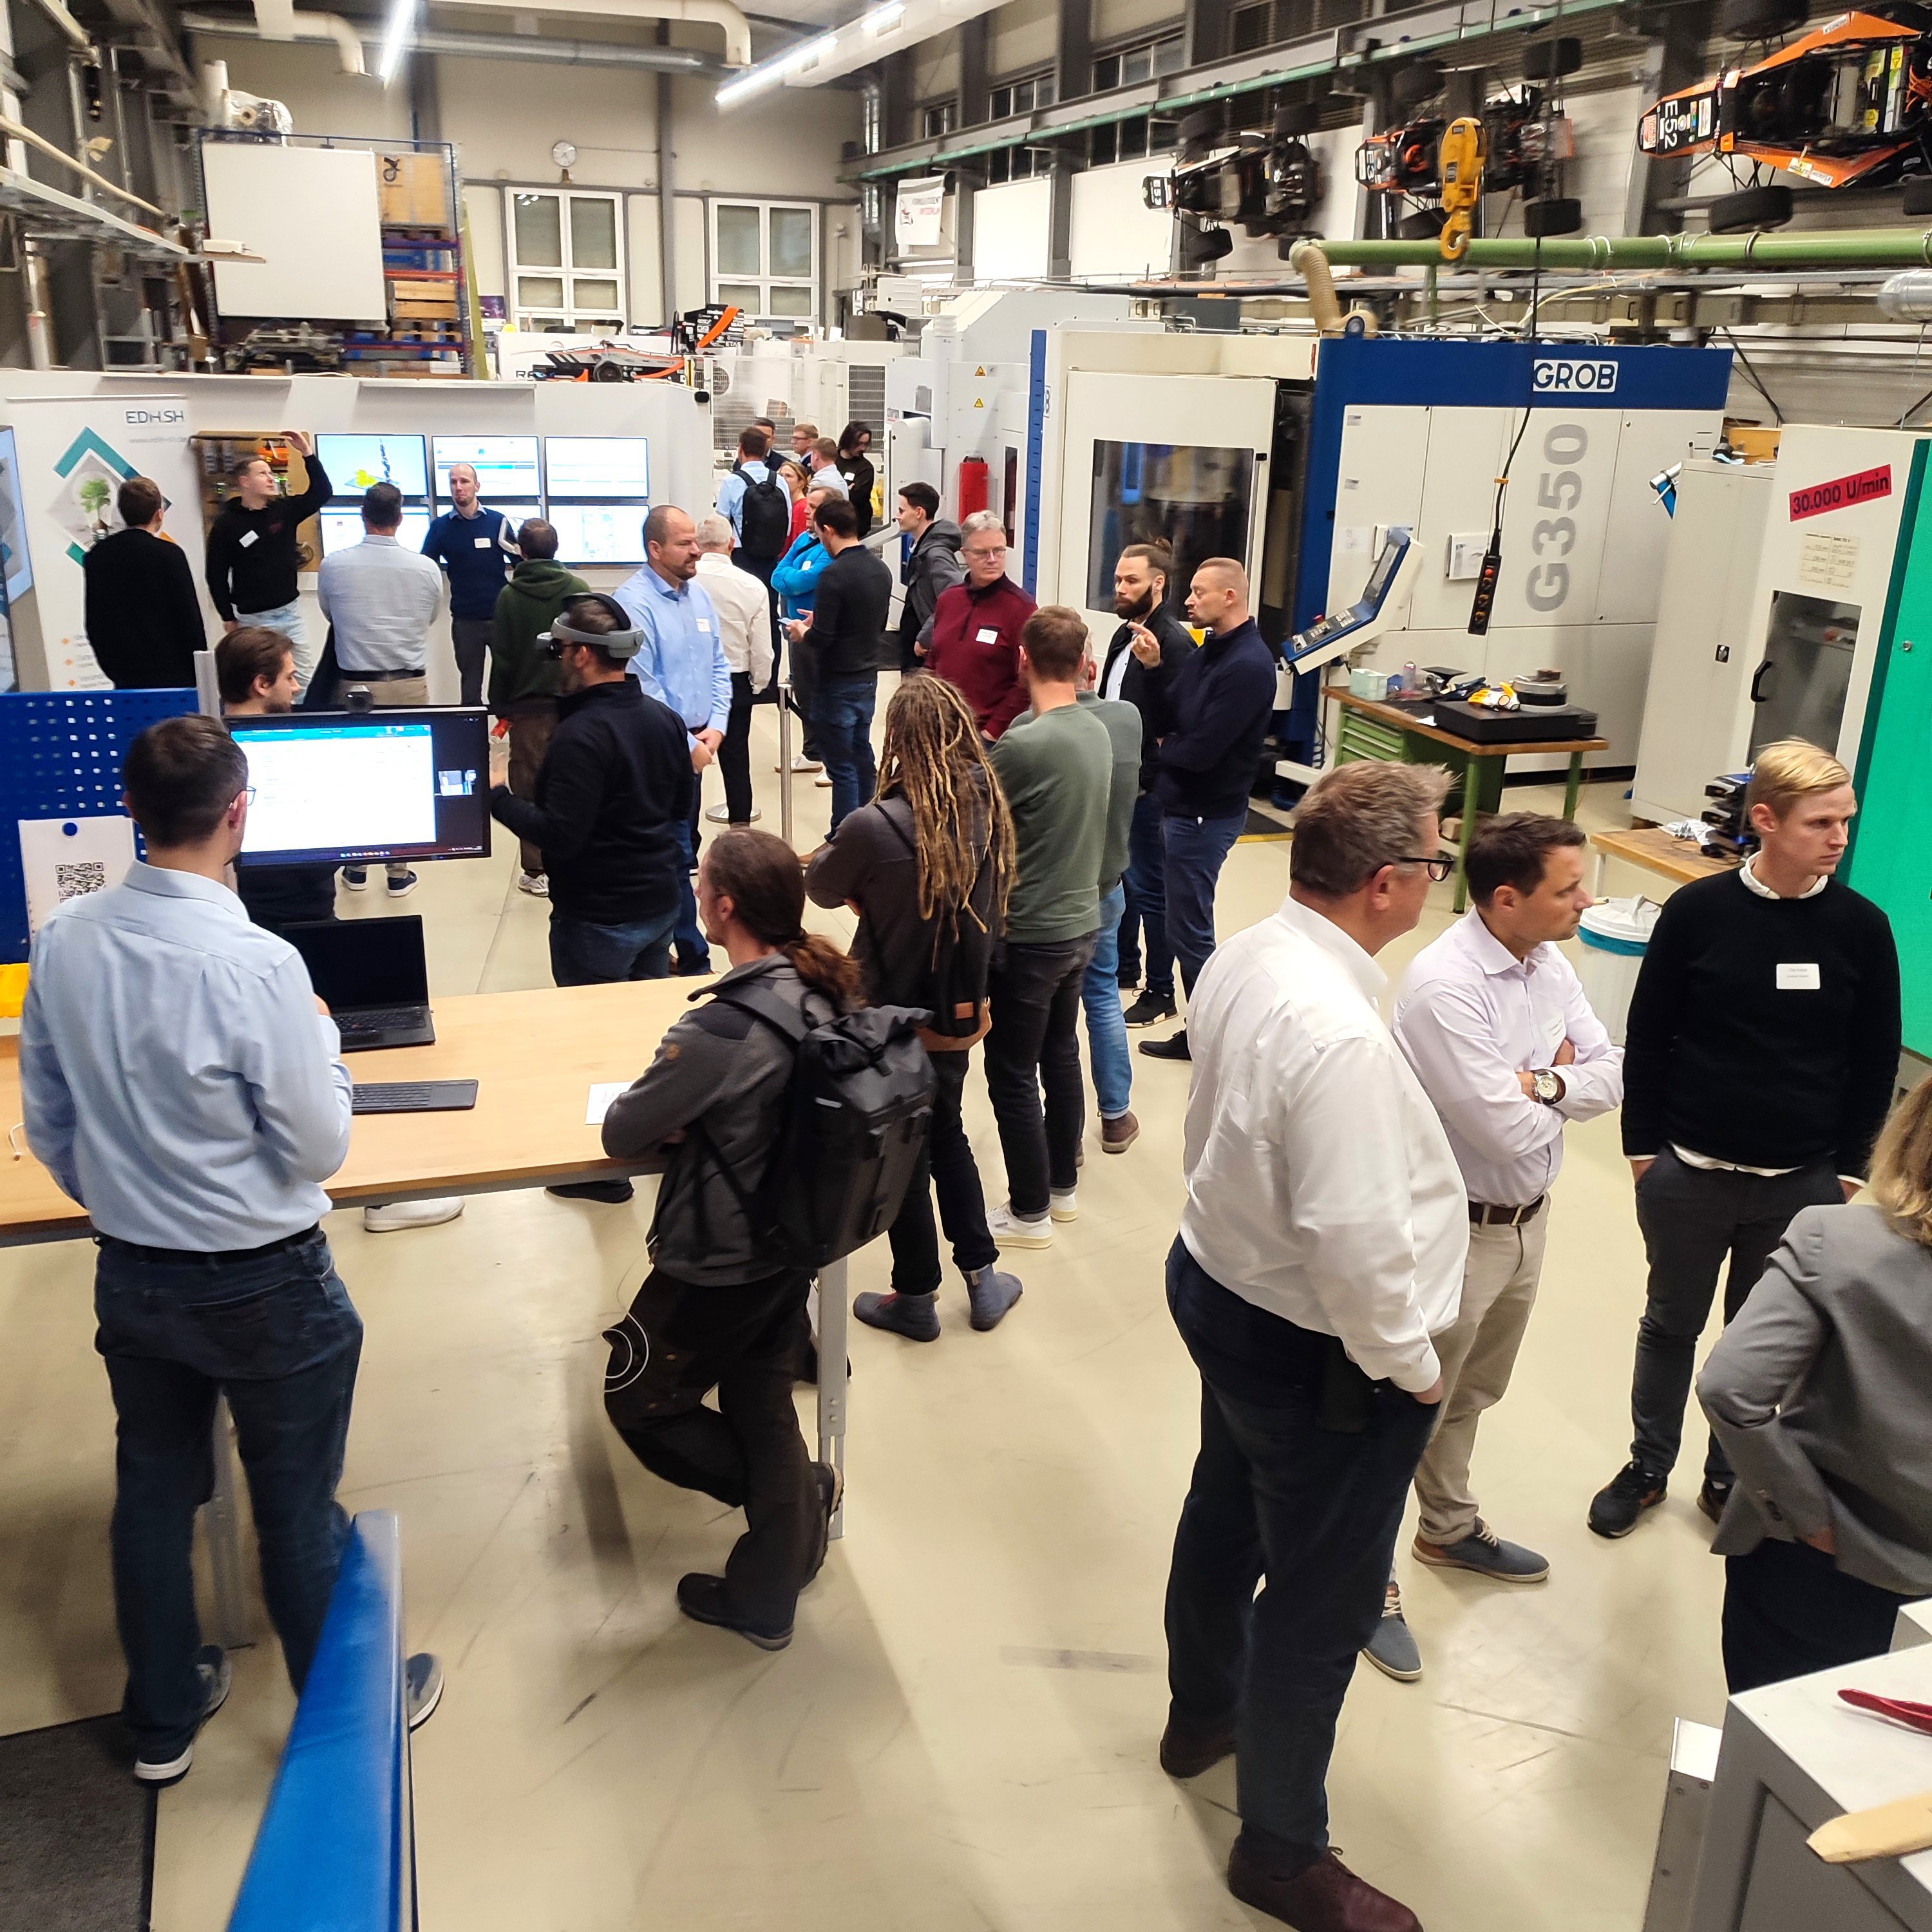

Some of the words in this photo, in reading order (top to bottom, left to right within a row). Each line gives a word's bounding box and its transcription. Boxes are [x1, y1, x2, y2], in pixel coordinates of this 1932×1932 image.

[1664, 100, 1678, 149] E52
[1153, 180, 1162, 205] E53
[1533, 362, 1615, 390] GROB
[1792, 485, 1842, 515] 30.000
[1846, 472, 1889, 499] U/min
[1525, 423, 1589, 612] G350
